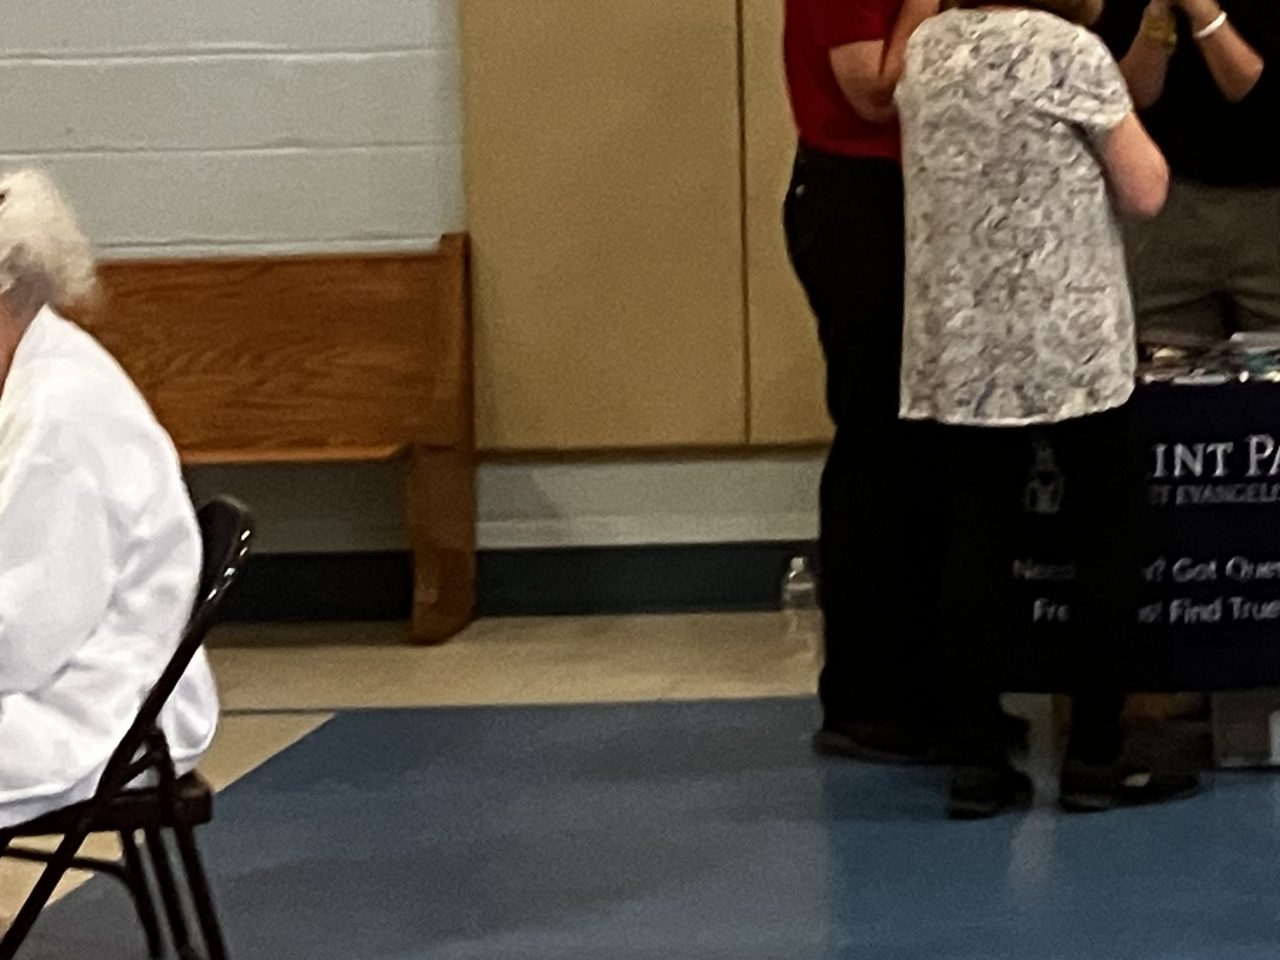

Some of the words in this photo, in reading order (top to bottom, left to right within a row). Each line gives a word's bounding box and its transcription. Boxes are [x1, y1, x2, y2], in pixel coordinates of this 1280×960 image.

[1150, 441, 1235, 479] INT
[1032, 596, 1072, 624] Fre
[1168, 595, 1224, 625] Find
